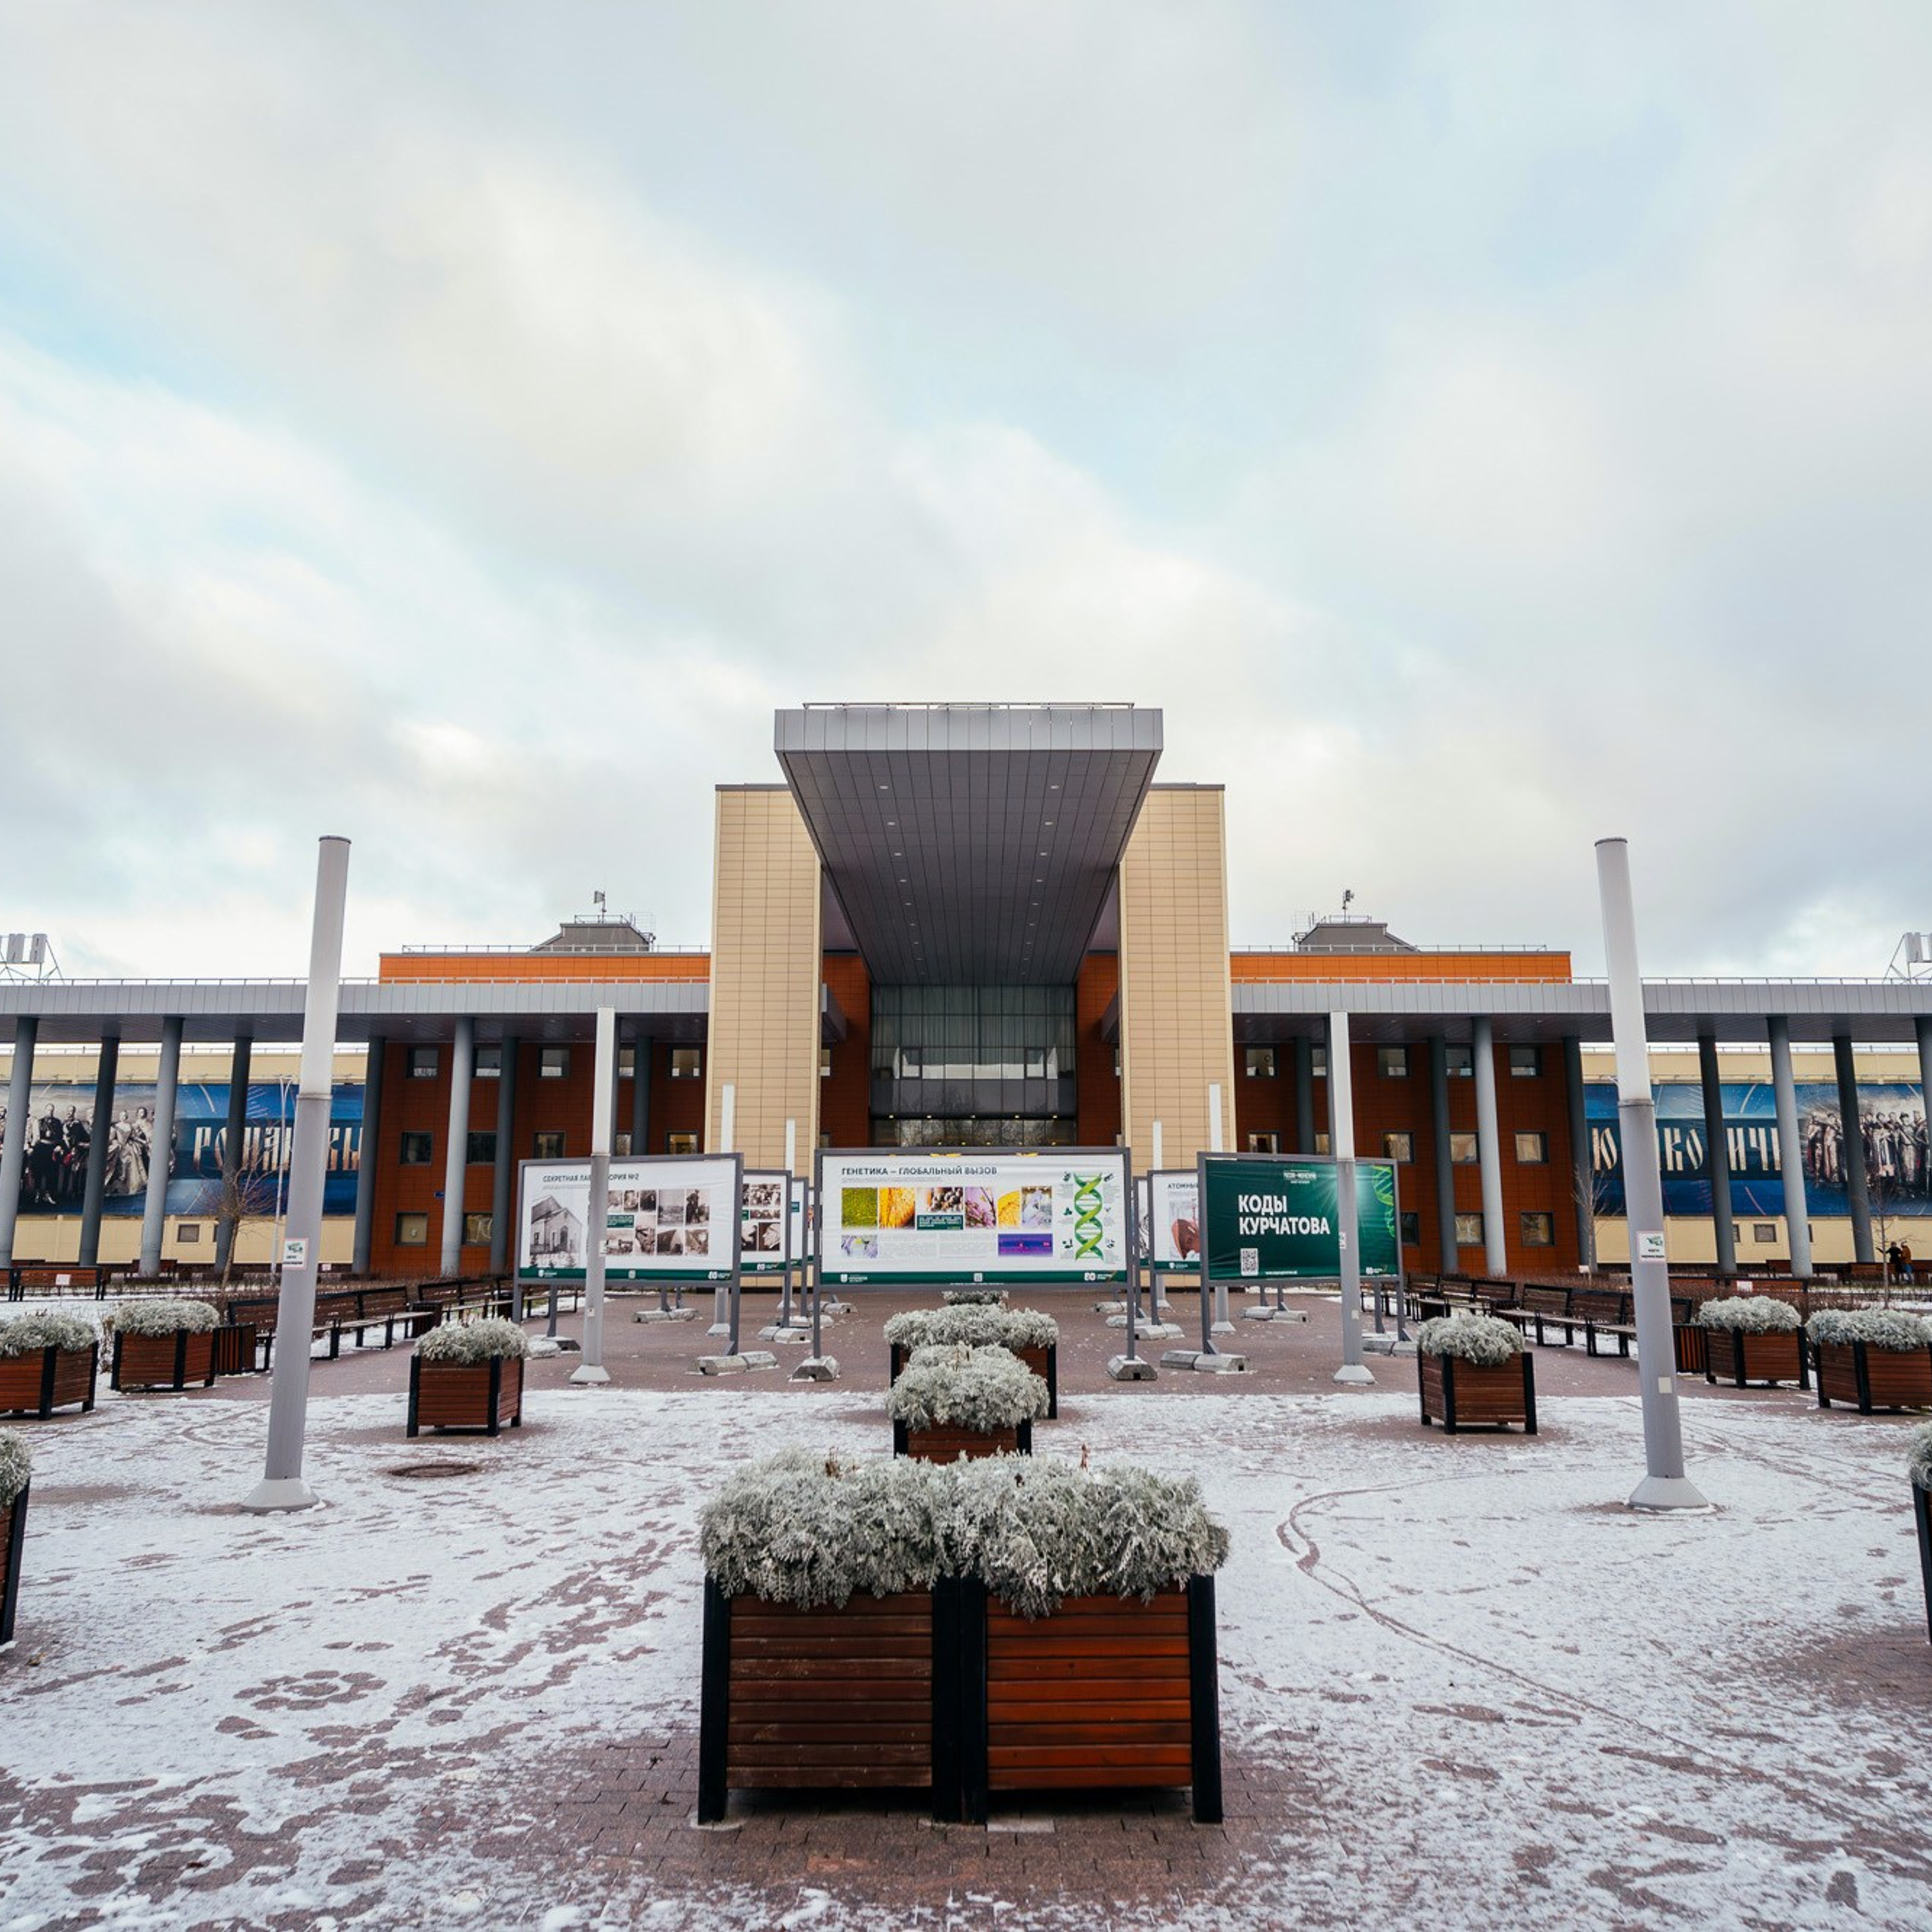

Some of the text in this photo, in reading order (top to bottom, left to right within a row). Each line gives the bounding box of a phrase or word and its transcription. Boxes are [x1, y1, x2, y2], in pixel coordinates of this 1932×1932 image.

[898, 1165, 962, 1175] ГЛОБАЛЬНЫЙ
[964, 1167, 998, 1175] ВЫЗОВ
[1238, 1195, 1287, 1216] КОДЫ
[1239, 1217, 1331, 1235] КУРЧАТОВА
